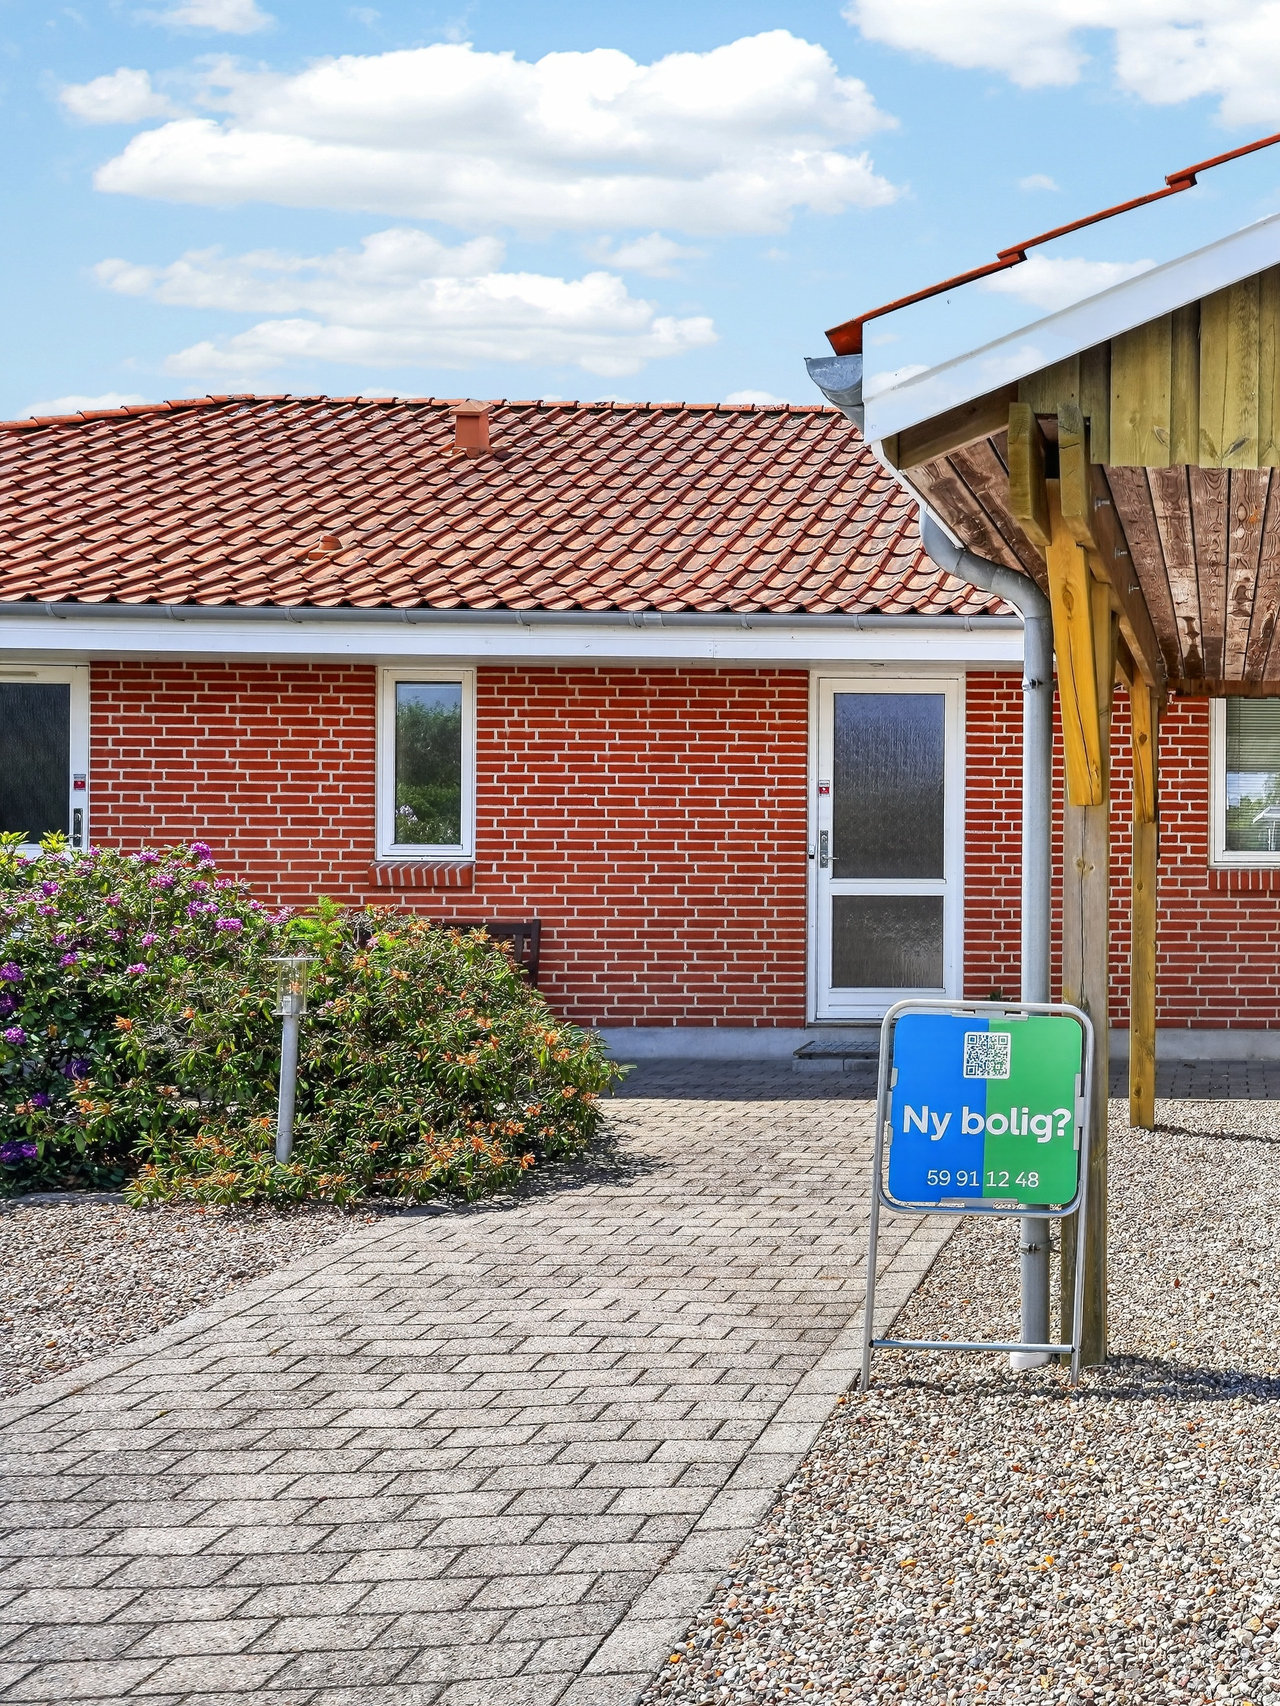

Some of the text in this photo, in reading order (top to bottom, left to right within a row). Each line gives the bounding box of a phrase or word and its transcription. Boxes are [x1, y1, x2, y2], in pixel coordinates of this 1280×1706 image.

[903, 1104, 1072, 1144] Ny bolig?
[926, 1169, 1039, 1188] 59 91 12 48
